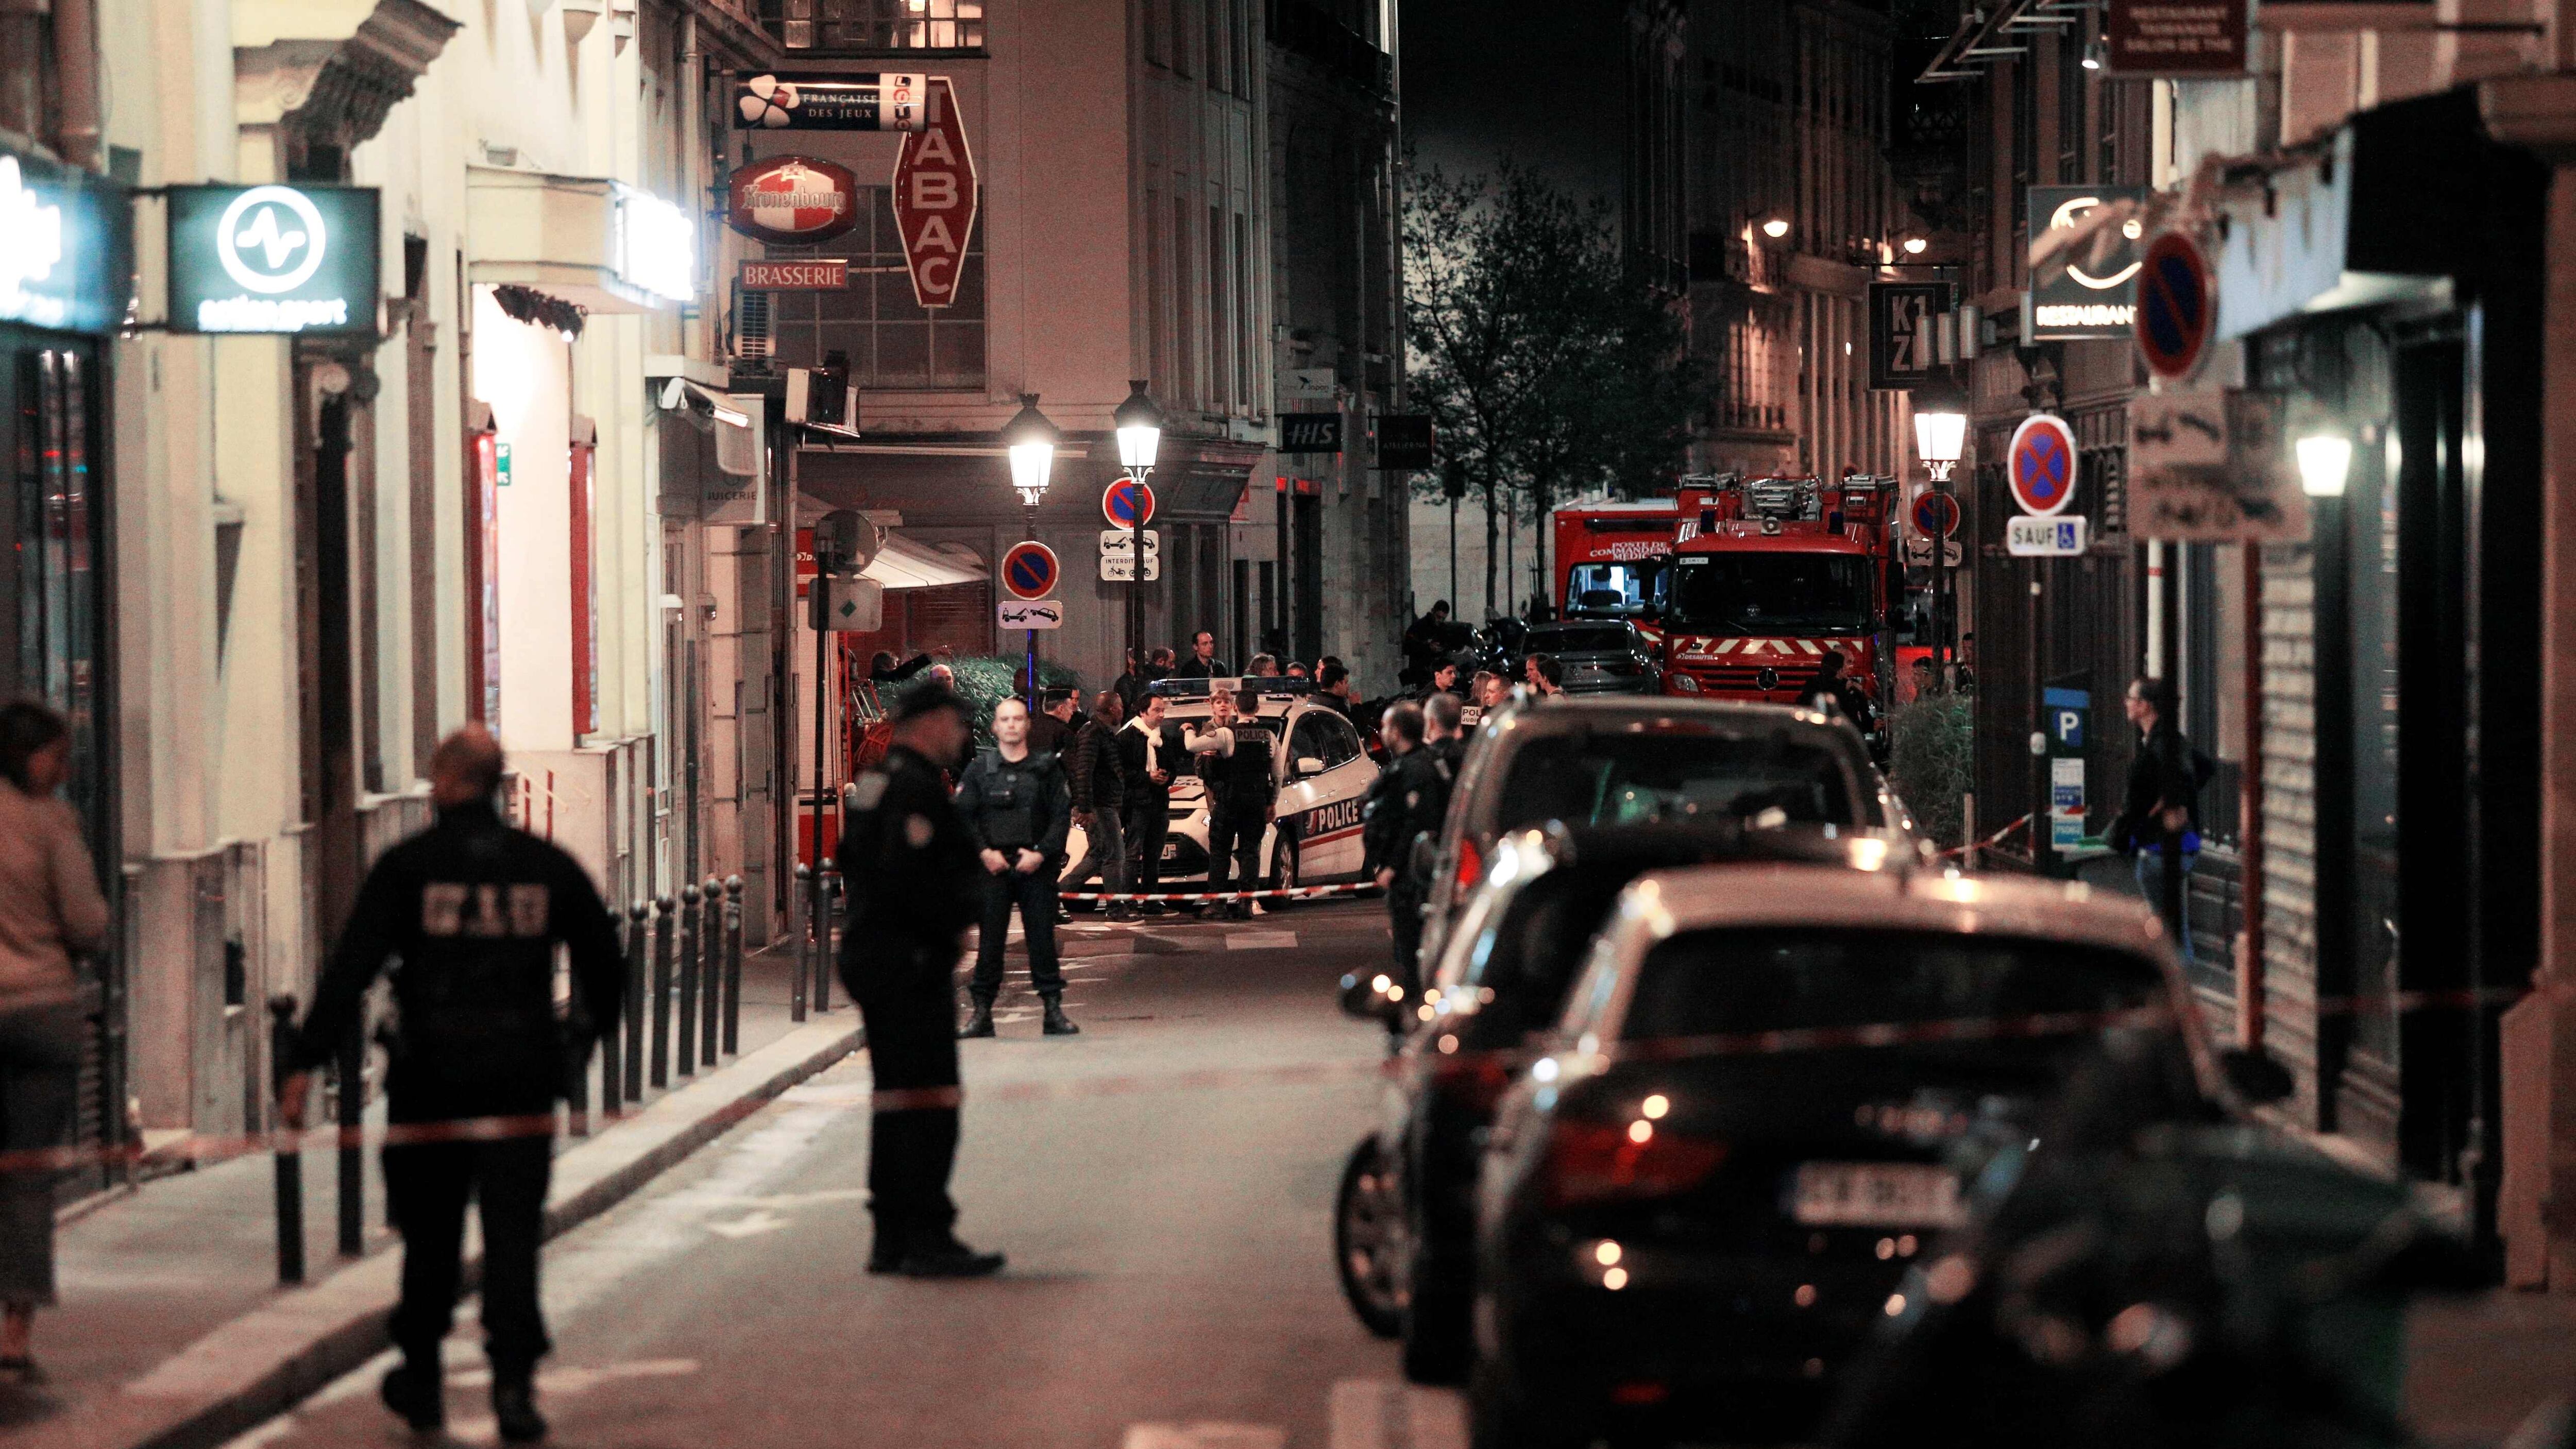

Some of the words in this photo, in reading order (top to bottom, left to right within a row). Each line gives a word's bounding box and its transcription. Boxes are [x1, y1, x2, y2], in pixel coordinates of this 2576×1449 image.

[809, 109, 832, 117] DES
[840, 109, 872, 118] JEUX
[741, 184, 846, 215] Kronenbourg
[912, 85, 958, 295] TABAC
[745, 267, 841, 285] BRASSERIE
[1289, 423, 1335, 445] HIS
[2014, 526, 2055, 545] SAUF
[1590, 547, 1672, 557] COMMANDEME
[1238, 730, 1269, 740] POLICE
[2061, 711, 2079, 741] P
[1319, 800, 1358, 831] POLICE
